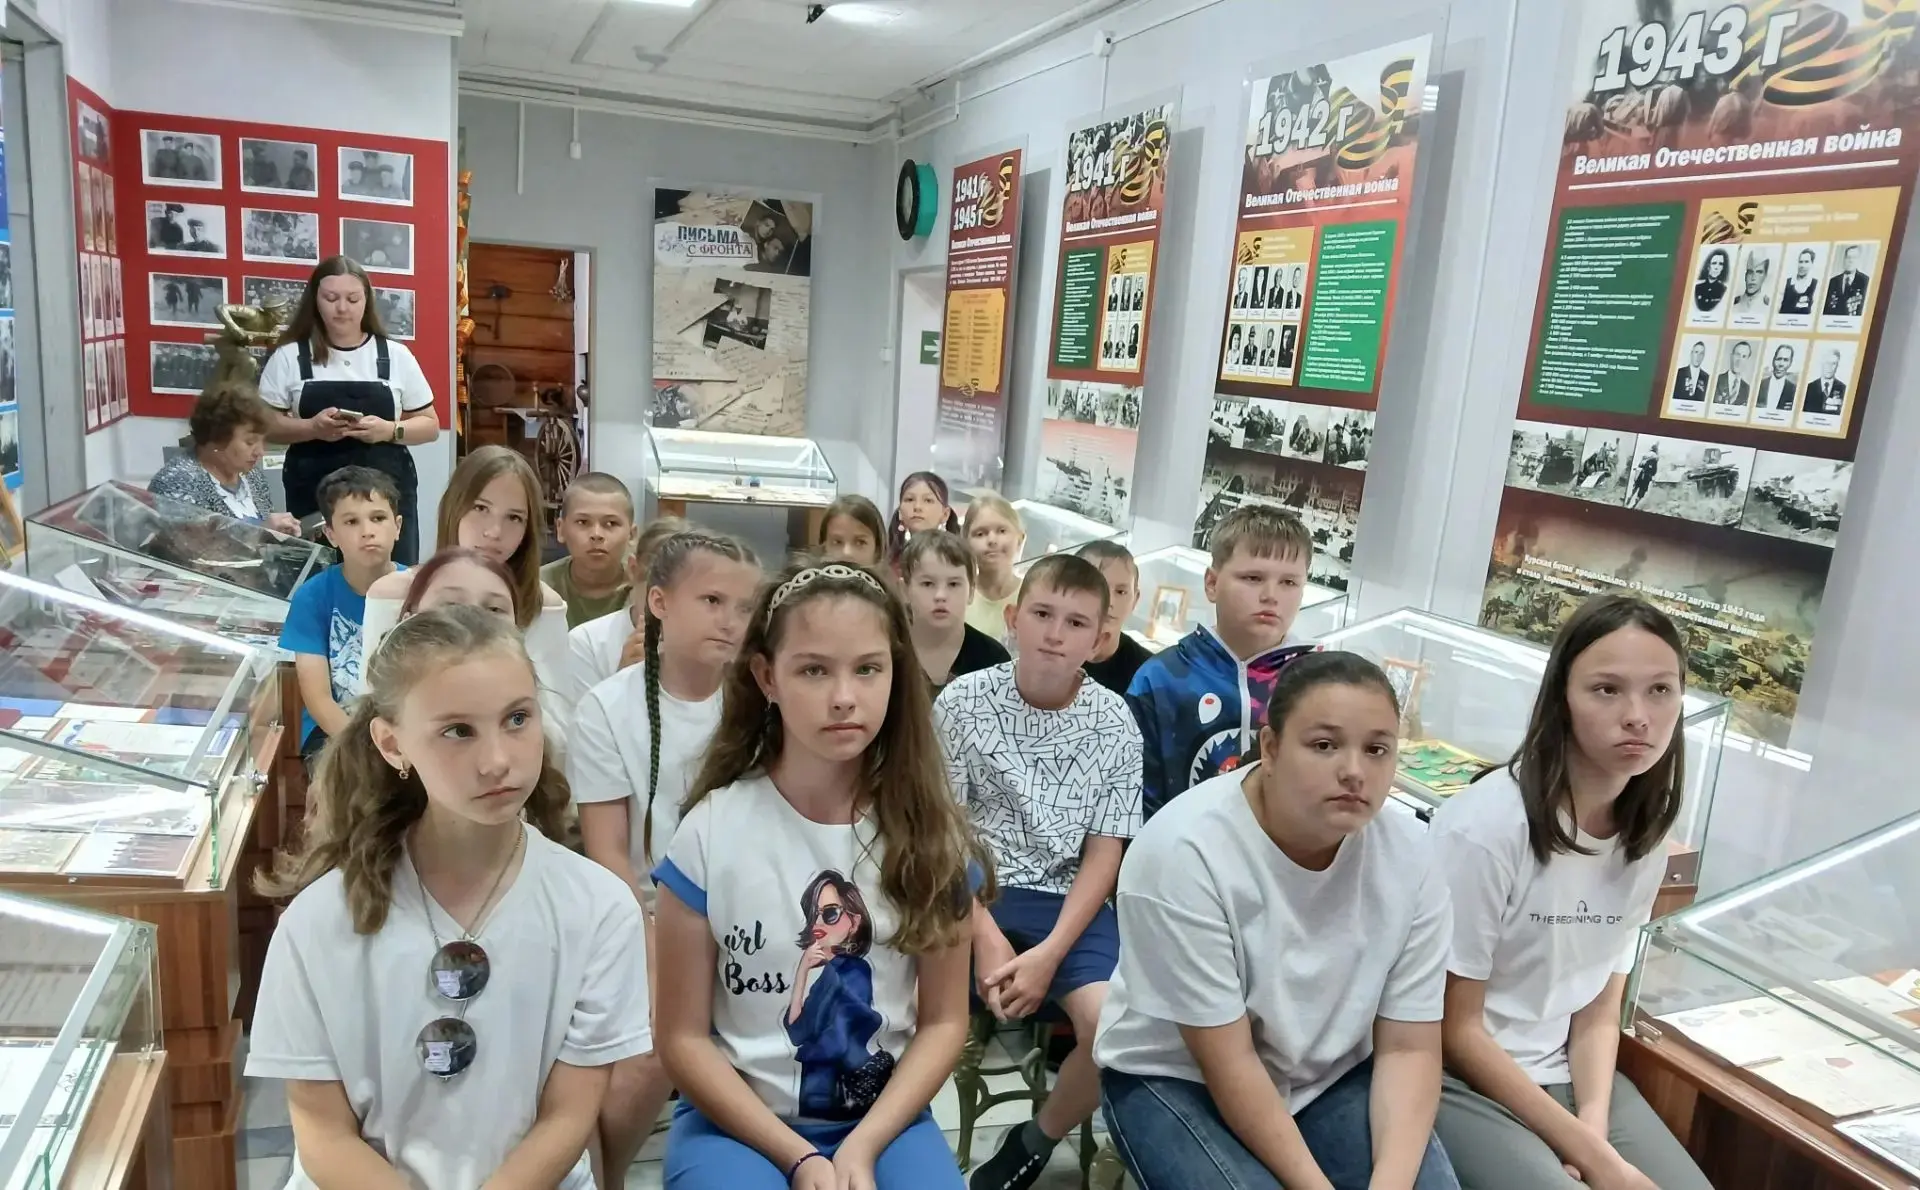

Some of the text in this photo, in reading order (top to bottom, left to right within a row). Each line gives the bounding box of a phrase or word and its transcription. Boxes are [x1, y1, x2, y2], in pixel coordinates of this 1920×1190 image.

[1593, 5, 1748, 92] 1943
[1256, 99, 1330, 156] 1942
[1574, 123, 1902, 175] Великая Отечественная война
[1071, 148, 1116, 192] 1941
[955, 174, 979, 203] 1941
[1245, 175, 1399, 208] Великая Отечественная война
[953, 204, 977, 231] 1945
[678, 226, 739, 245] ПИСЬМА
[700, 244, 752, 255] ФРОНТА
[1675, 591, 1687, 602] 23
[1687, 597, 1721, 613] августа
[1555, 914, 1602, 925] BEGNING
[725, 961, 791, 996] Boss
